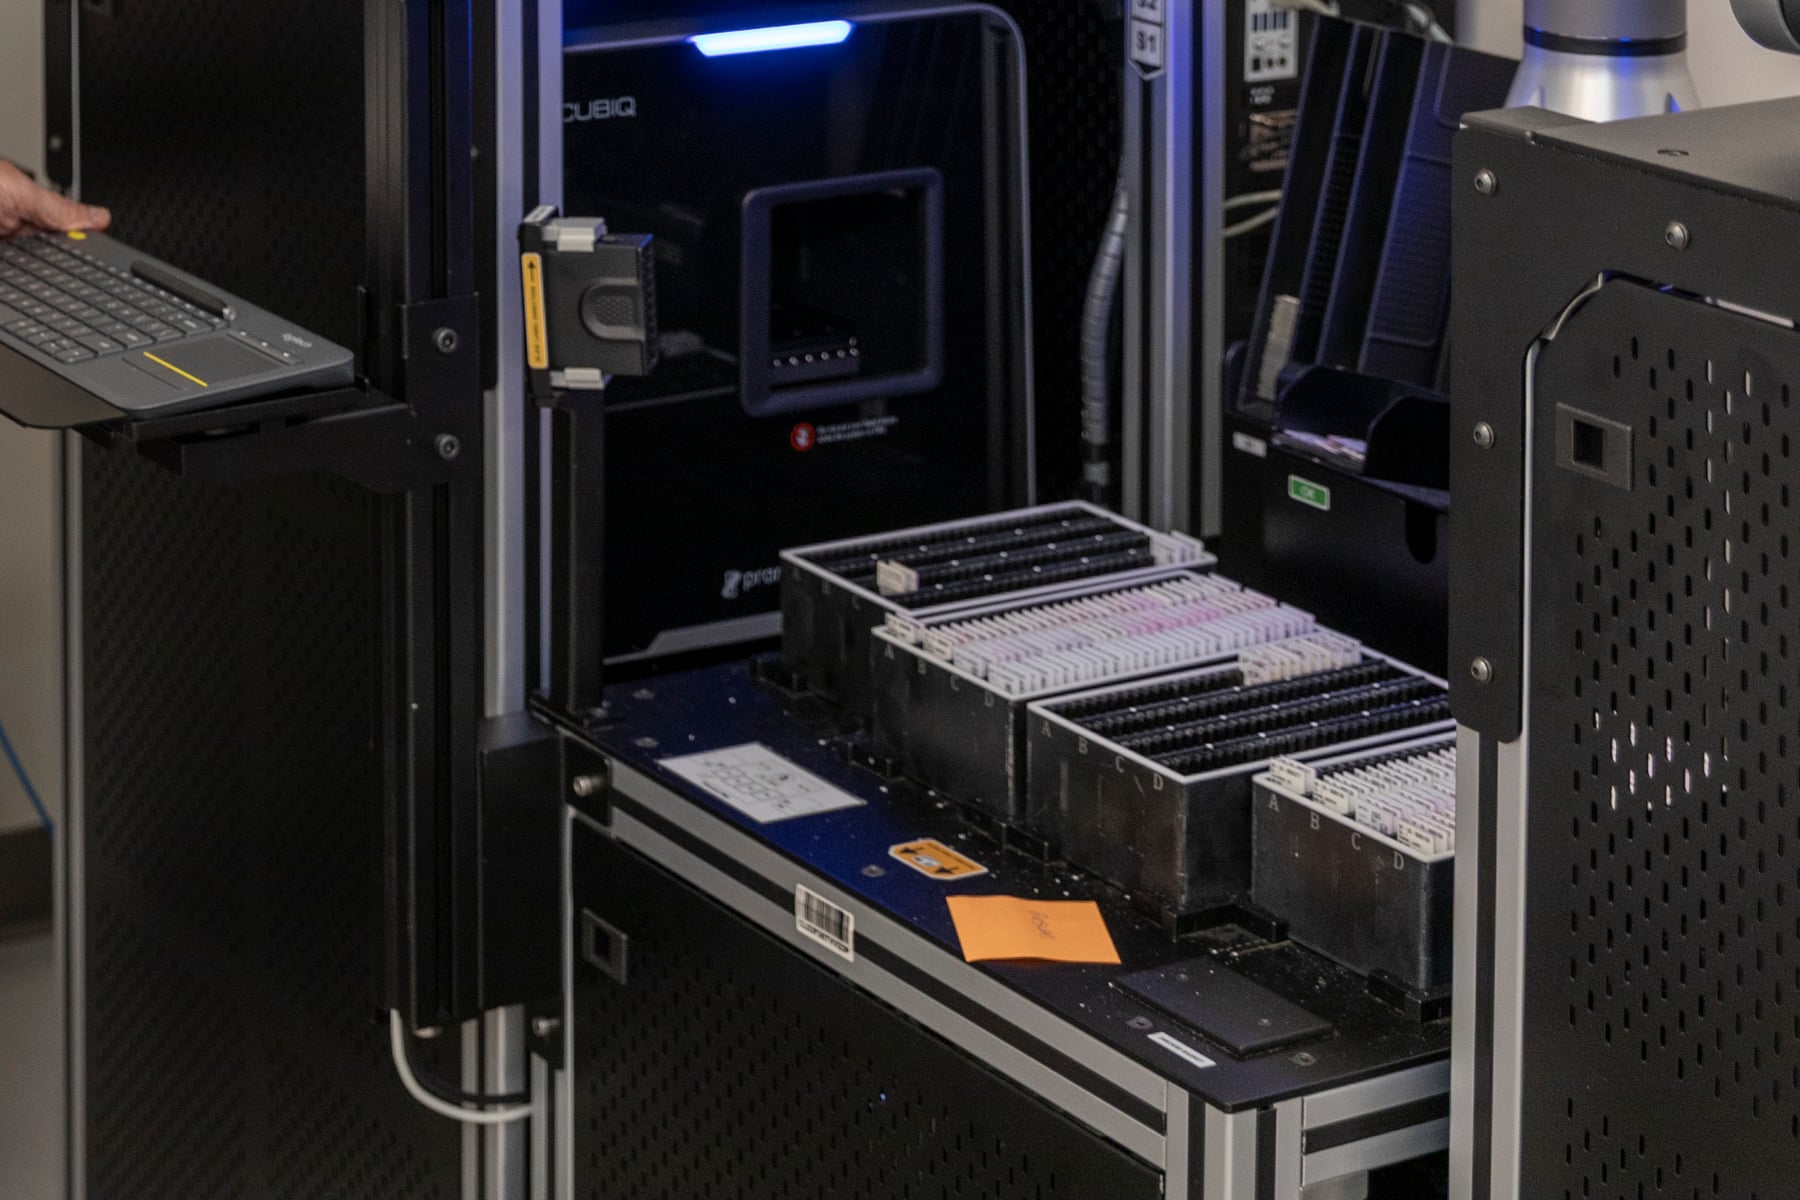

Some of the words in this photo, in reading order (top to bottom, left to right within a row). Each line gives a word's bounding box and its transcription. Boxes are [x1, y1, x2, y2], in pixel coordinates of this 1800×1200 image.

[1135, 30, 1157, 54] S1
[1041, 720, 1052, 738] A
[1078, 736, 1089, 755] B
[1114, 755, 1125, 773] C
[1153, 773, 1164, 791] D
[1268, 794, 1280, 813] A
[1309, 812, 1321, 831] B
[1351, 833, 1362, 851] C
[1393, 852, 1405, 870] D
